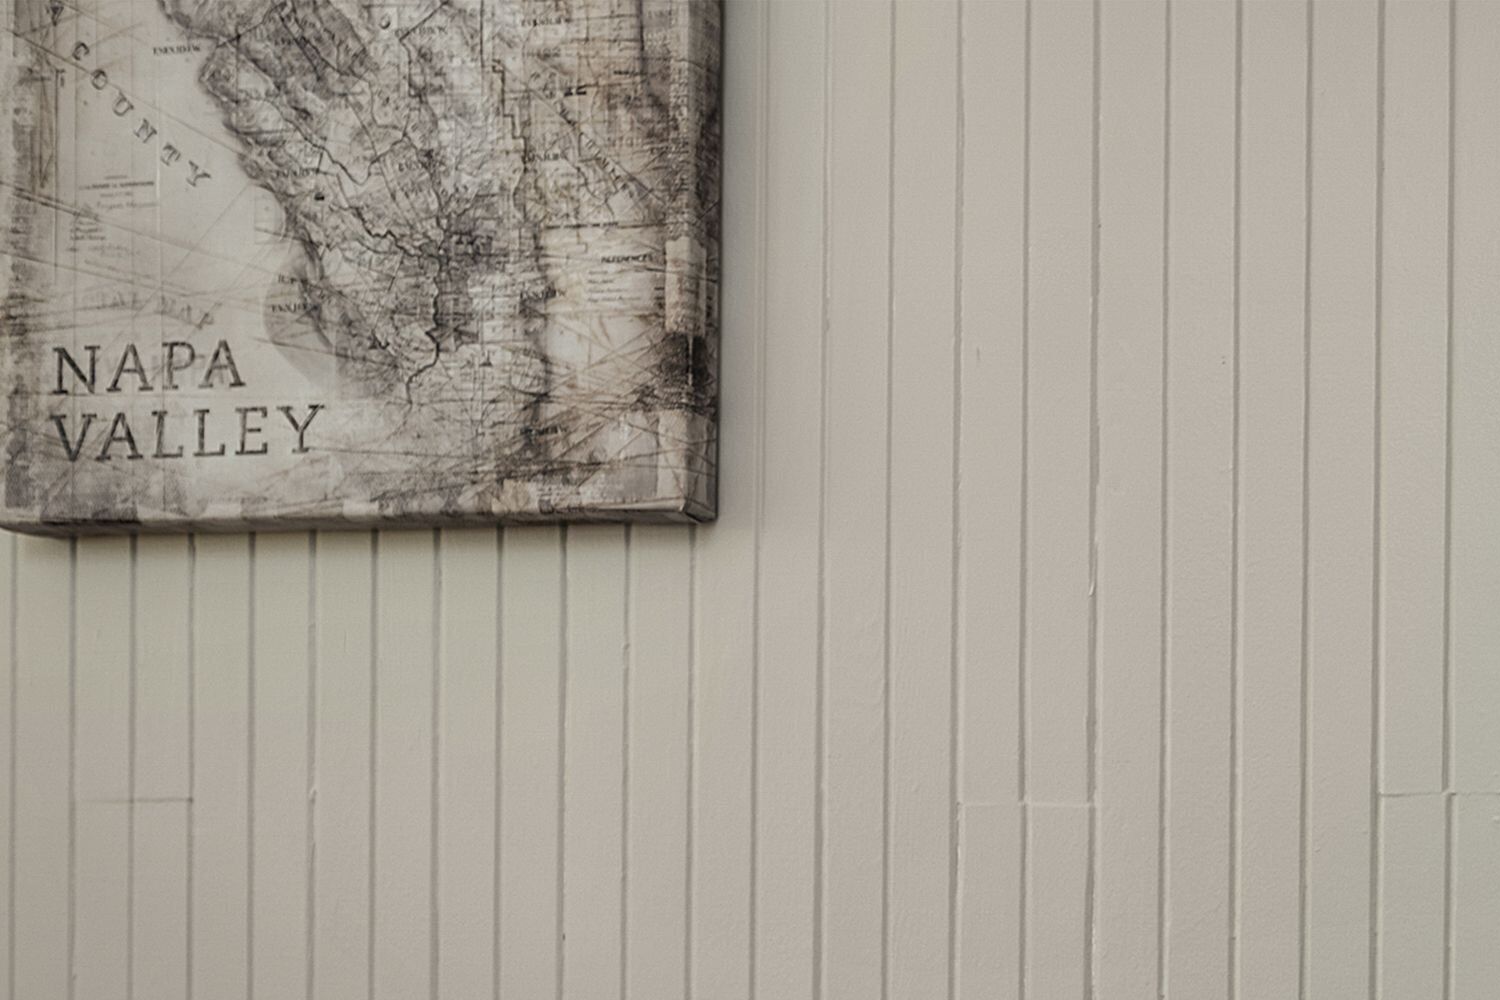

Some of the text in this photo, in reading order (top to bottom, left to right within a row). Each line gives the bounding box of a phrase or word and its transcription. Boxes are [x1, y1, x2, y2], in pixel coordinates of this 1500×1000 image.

[70, 40, 212, 188] COUNTY
[51, 338, 247, 396] NAPA
[49, 403, 326, 463] VALLEY
